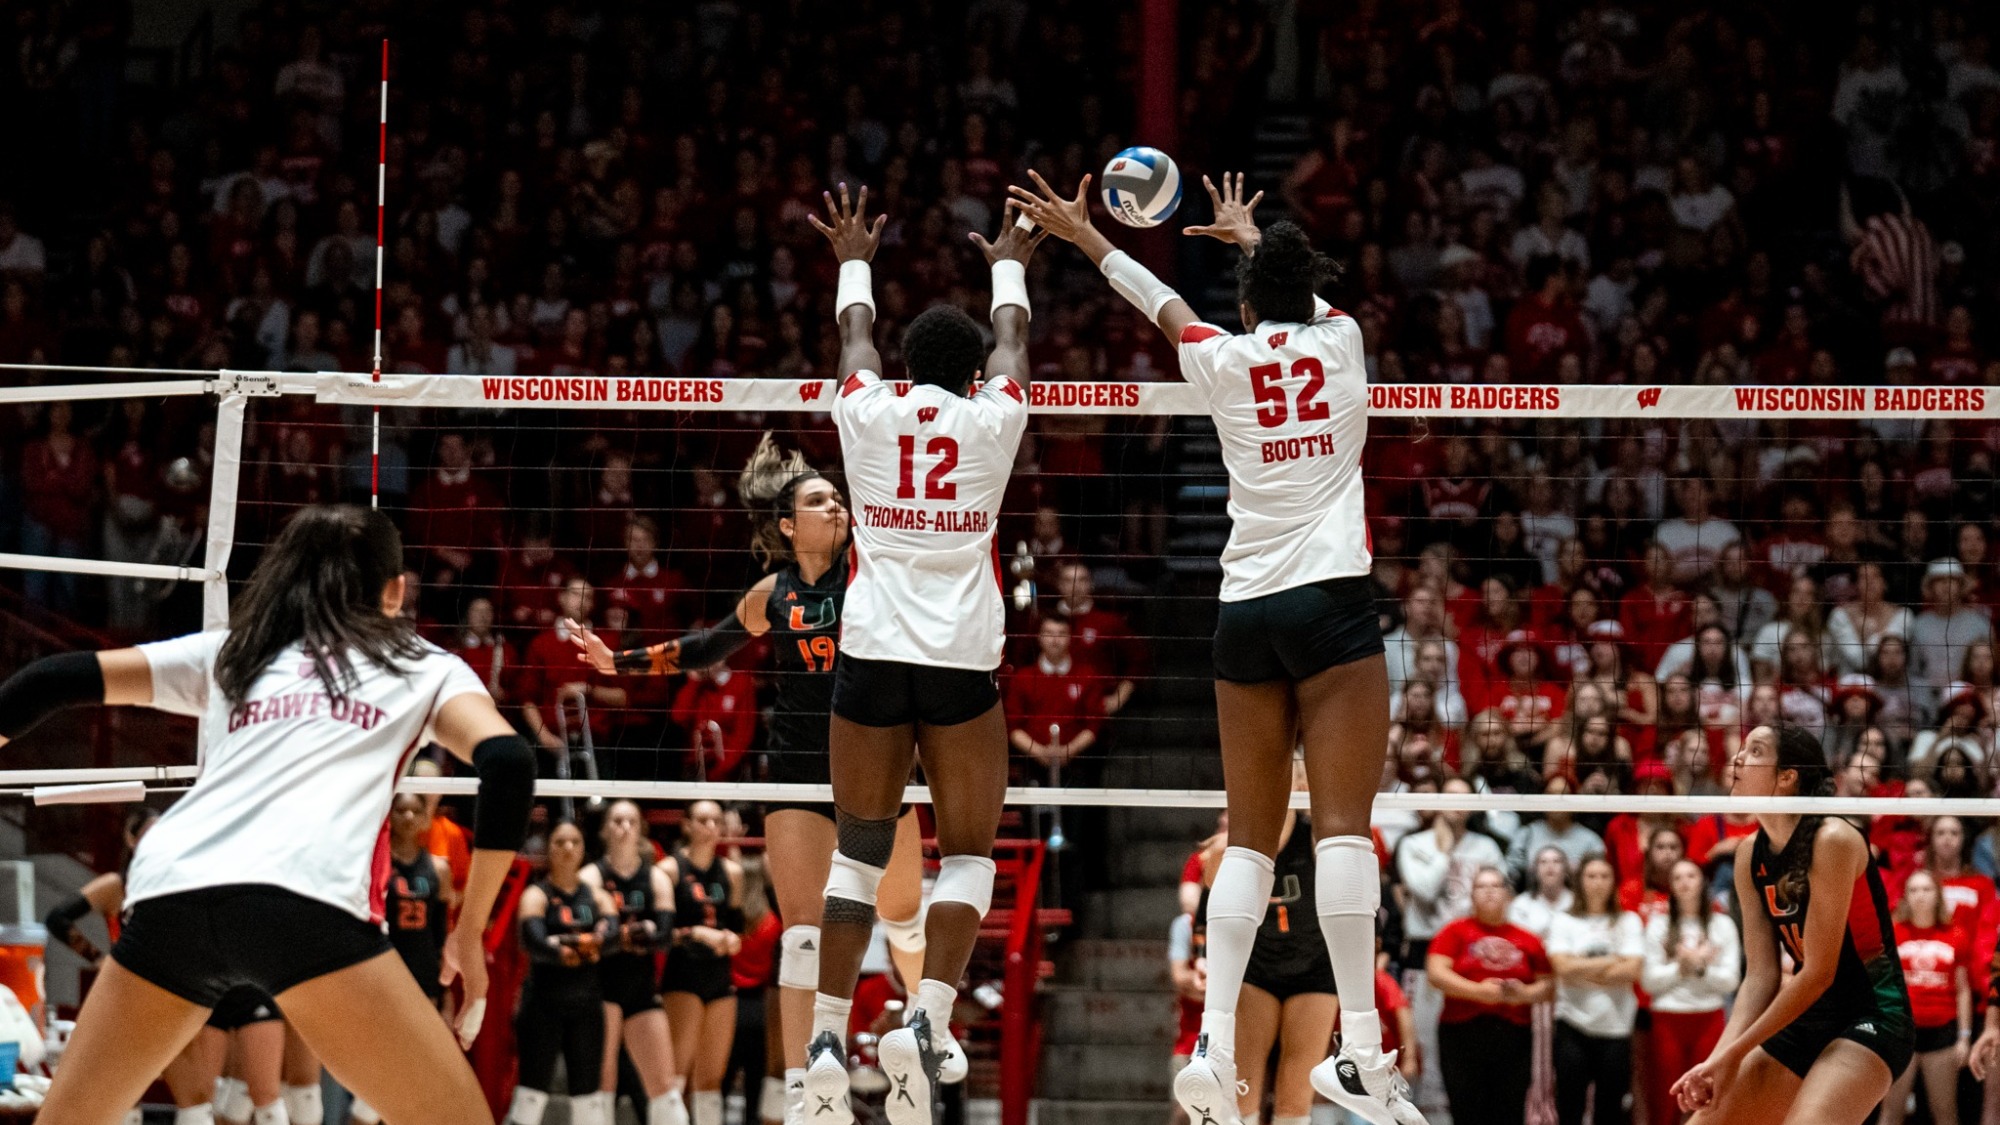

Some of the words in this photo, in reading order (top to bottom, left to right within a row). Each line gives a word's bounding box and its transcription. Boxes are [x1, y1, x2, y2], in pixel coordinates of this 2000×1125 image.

[482, 377, 609, 402] WISCONSIN
[616, 379, 725, 403] BADGERS
[1029, 383, 1140, 408] BADGERS
[1249, 356, 1331, 429] 52
[1450, 385, 1561, 411] BADGERS
[1734, 387, 1867, 412] WISCONSIN
[1873, 387, 1986, 412] BADGERS
[1260, 433, 1336, 465] BOOTH
[896, 434, 959, 501] 12
[863, 504, 989, 533] THOMAS-AILARA
[797, 635, 836, 672] 19
[227, 691, 389, 734] CRAWFORD
